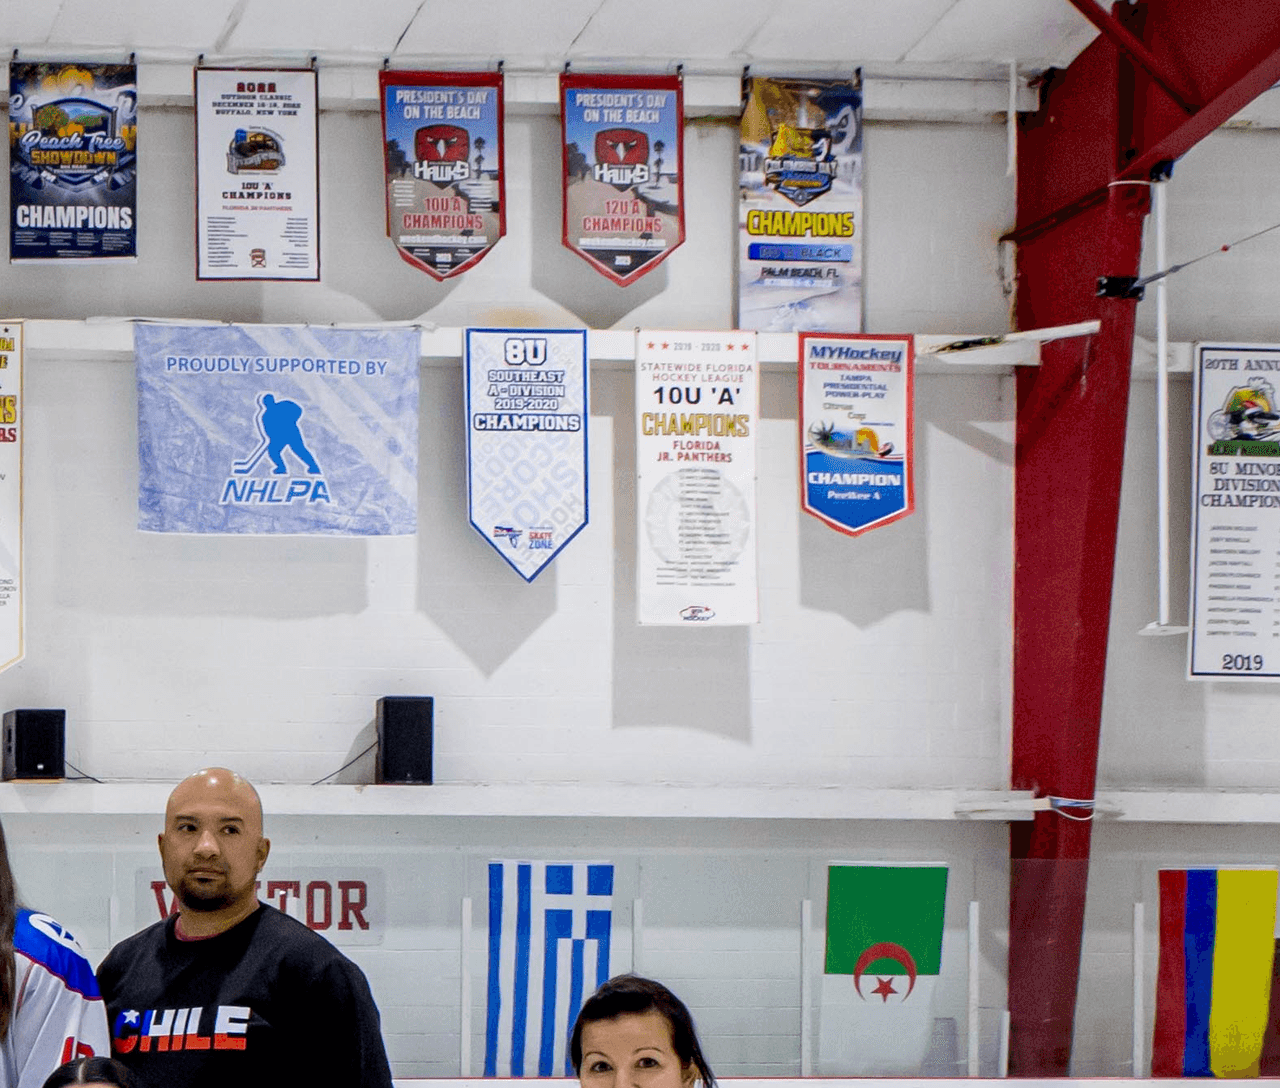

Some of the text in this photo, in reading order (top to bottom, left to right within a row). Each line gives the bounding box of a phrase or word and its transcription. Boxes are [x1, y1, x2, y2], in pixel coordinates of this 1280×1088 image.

[396, 90, 488, 104] PRESIDENT'S DAY
[576, 93, 667, 108] PRESIDENT'S DAY
[403, 105, 481, 119] ON THE BEACH
[583, 108, 660, 123] ON THE BEACH
[21, 130, 126, 153] Peach Tree
[31, 150, 117, 165] SHOWDOWN
[222, 191, 292, 200] CHAMPIONS
[425, 197, 461, 212] 10U A
[605, 200, 641, 214] 12U A
[16, 204, 133, 230] CHAMPIONS
[403, 213, 483, 230] CHAMPIONS
[583, 216, 663, 233] CHAMPIONS
[747, 210, 854, 237] CHAMPIONS
[505, 337, 547, 366] 8U
[809, 345, 902, 364] MYHockey
[166, 356, 387, 375] PROUDLY SUPPORTED BY
[641, 362, 753, 373] STATEWIDE FLORIDA
[487, 369, 565, 383] SOUTHEAST
[652, 373, 744, 383] HOCKEY LEAGUE
[653, 386, 701, 405] 10U
[494, 397, 559, 411] 2019-2020
[473, 413, 581, 432] CHAMPIONS
[641, 412, 750, 438] CHAMPIONS
[673, 440, 721, 451] FLORIDA
[677, 452, 733, 463] PANTHERS
[808, 472, 901, 486] CHAMPION
[220, 478, 332, 505] NHLPA
[528, 539, 553, 549] ZONE
[1222, 653, 1264, 671] 2019
[112, 1005, 251, 1053] CHILE
